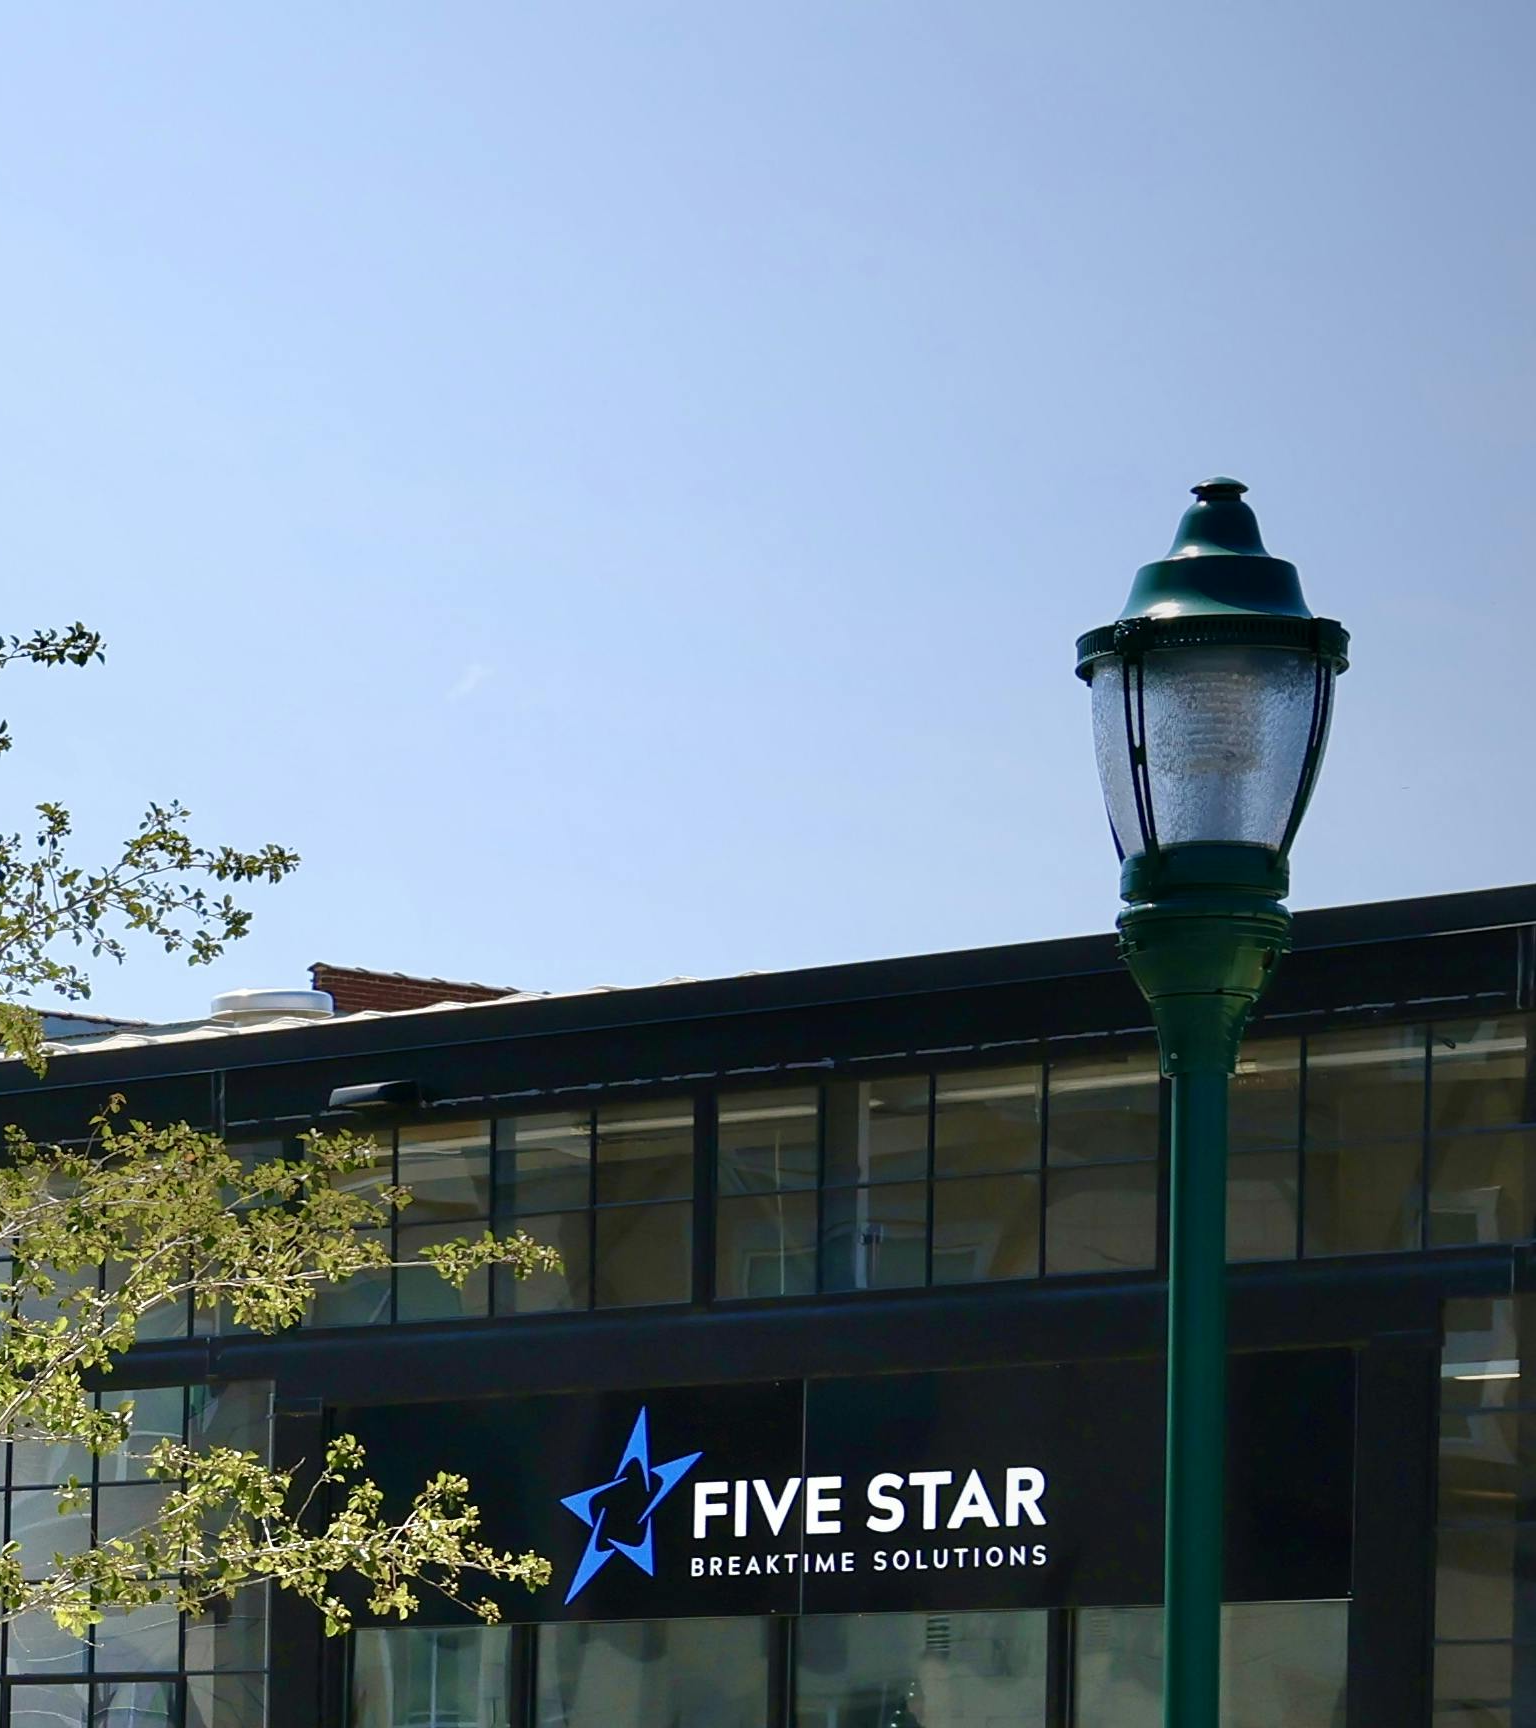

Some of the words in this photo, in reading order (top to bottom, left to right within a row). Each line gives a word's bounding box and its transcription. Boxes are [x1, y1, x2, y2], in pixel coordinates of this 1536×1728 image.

[694, 1475, 842, 1539] FIVE
[866, 1466, 1047, 1533] STAR
[690, 1552, 856, 1577] BREAKTIME
[873, 1544, 1047, 1571] SOLUTIONS
